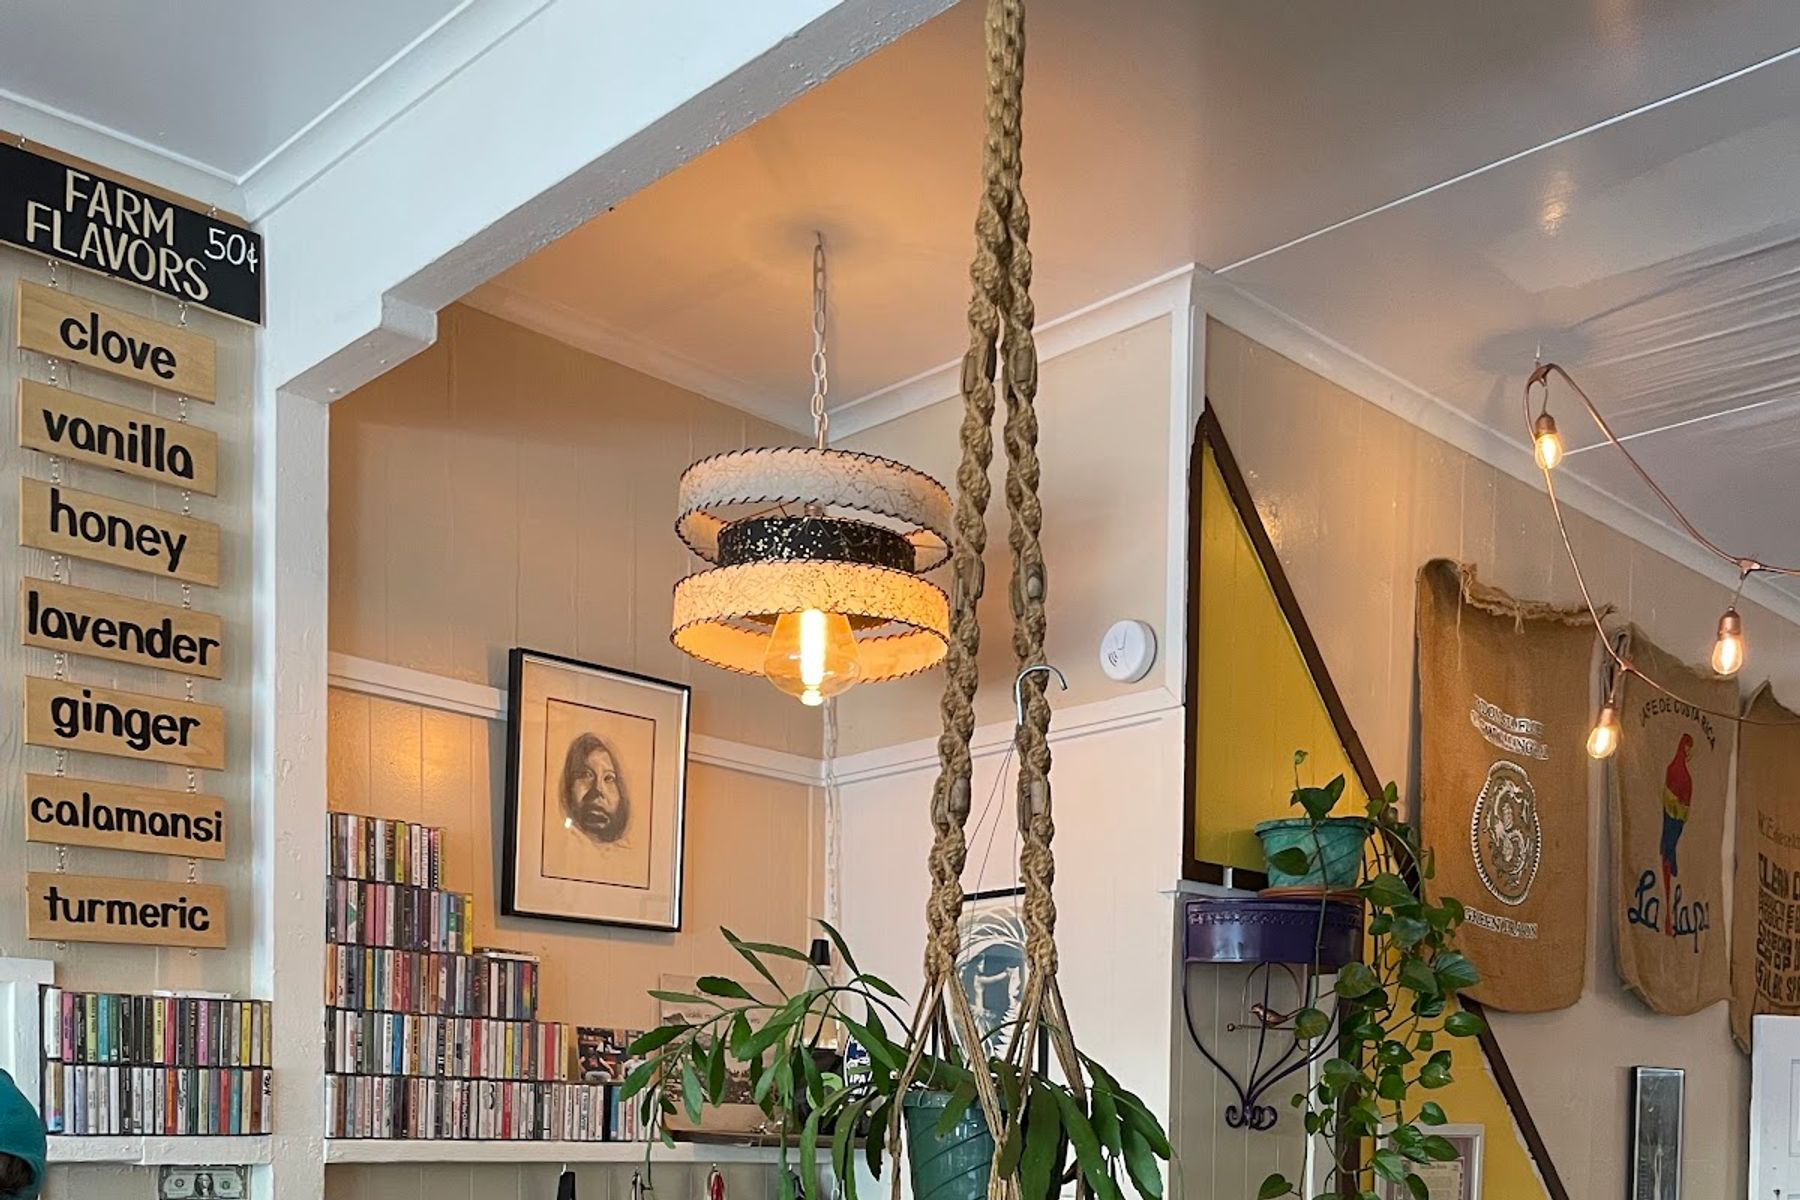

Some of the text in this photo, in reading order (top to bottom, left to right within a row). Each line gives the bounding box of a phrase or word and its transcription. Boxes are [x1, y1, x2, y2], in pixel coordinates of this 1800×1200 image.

[65, 168, 174, 246] FARM
[26, 200, 210, 301] FLAVORS
[204, 227, 258, 275] 50¢
[60, 311, 177, 380] clove
[42, 408, 194, 480] vanilla
[50, 487, 188, 573] honey
[28, 591, 220, 666] lavender
[51, 689, 201, 752] ginger
[30, 792, 222, 843] calamansi
[43, 886, 210, 932] turmeric
